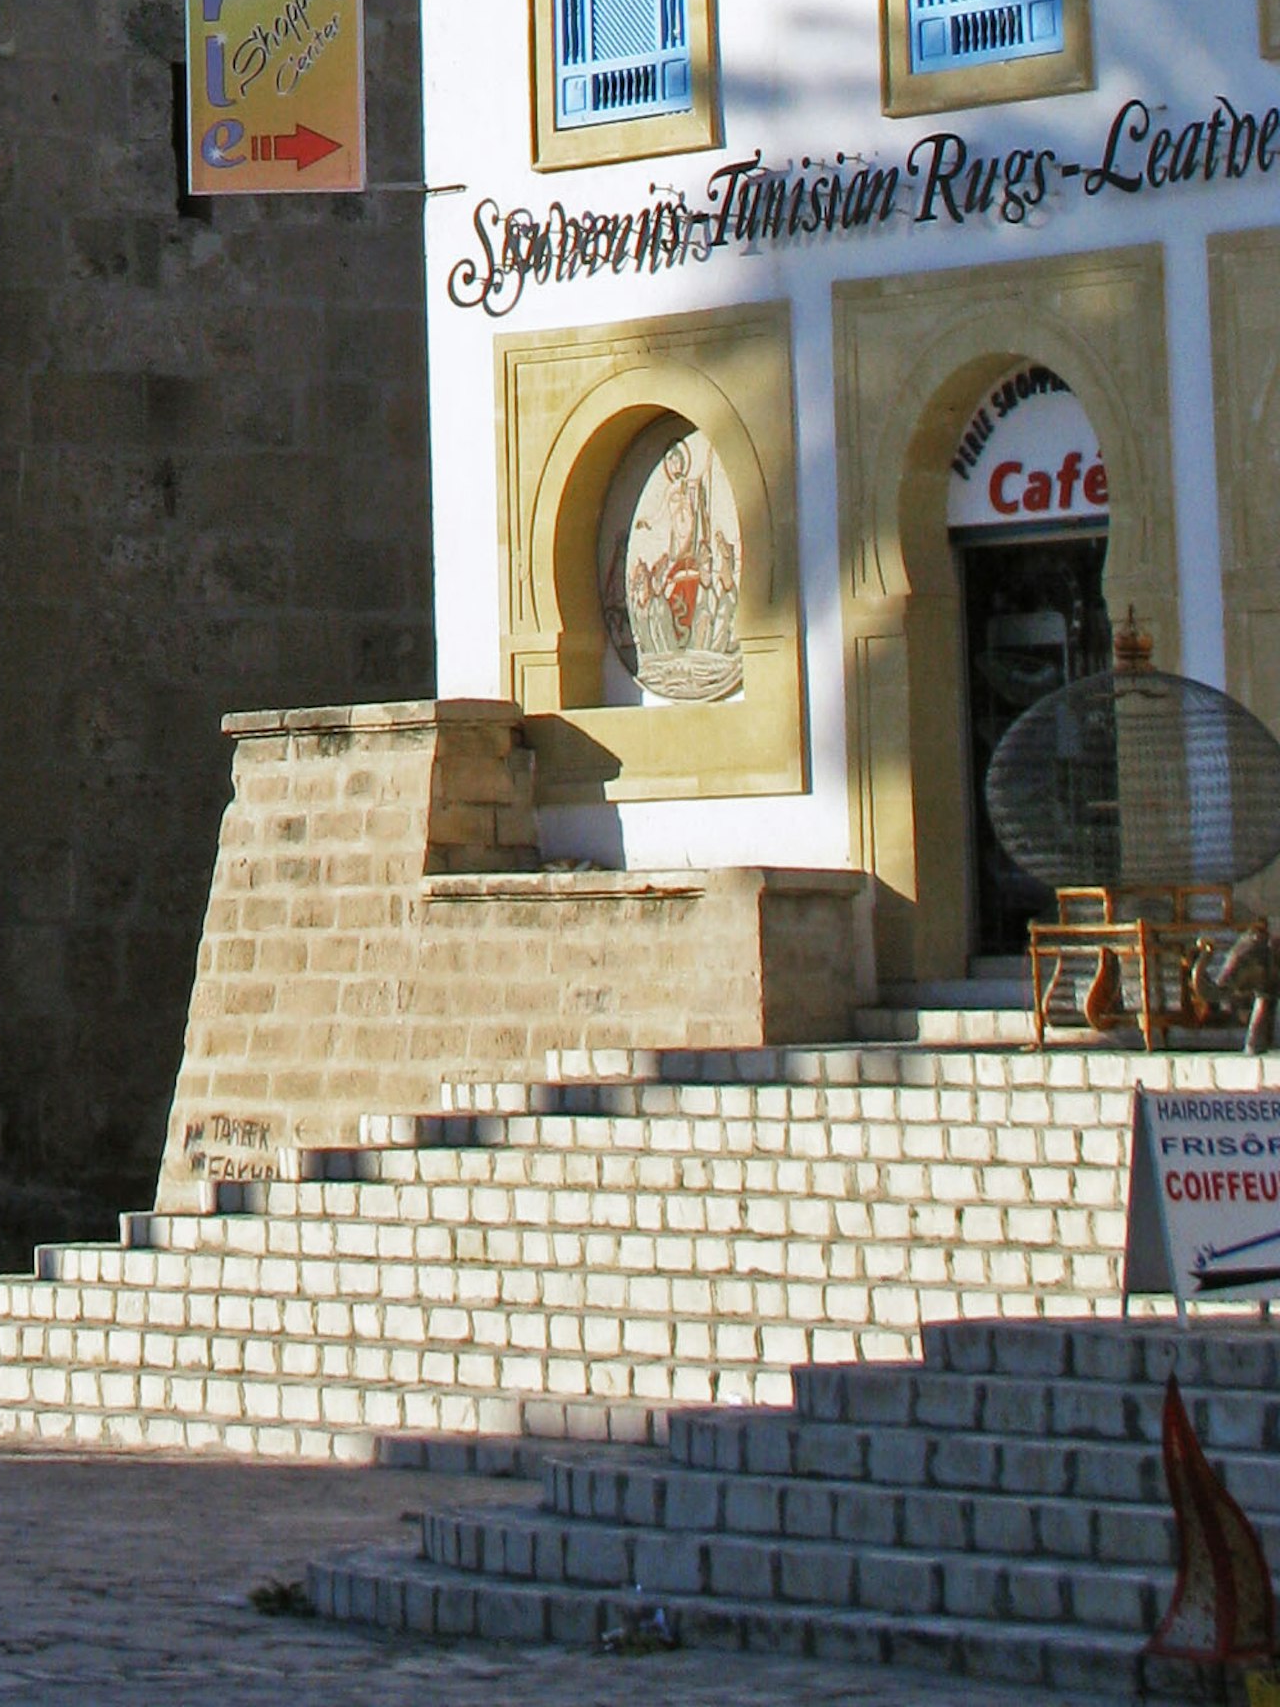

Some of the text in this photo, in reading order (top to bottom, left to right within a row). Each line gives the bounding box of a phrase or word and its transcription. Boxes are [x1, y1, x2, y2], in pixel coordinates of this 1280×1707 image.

[276, 13, 339, 95] Center
[989, 450, 1109, 515] Café
[1165, 1170, 1280, 1203] COIFFEU
